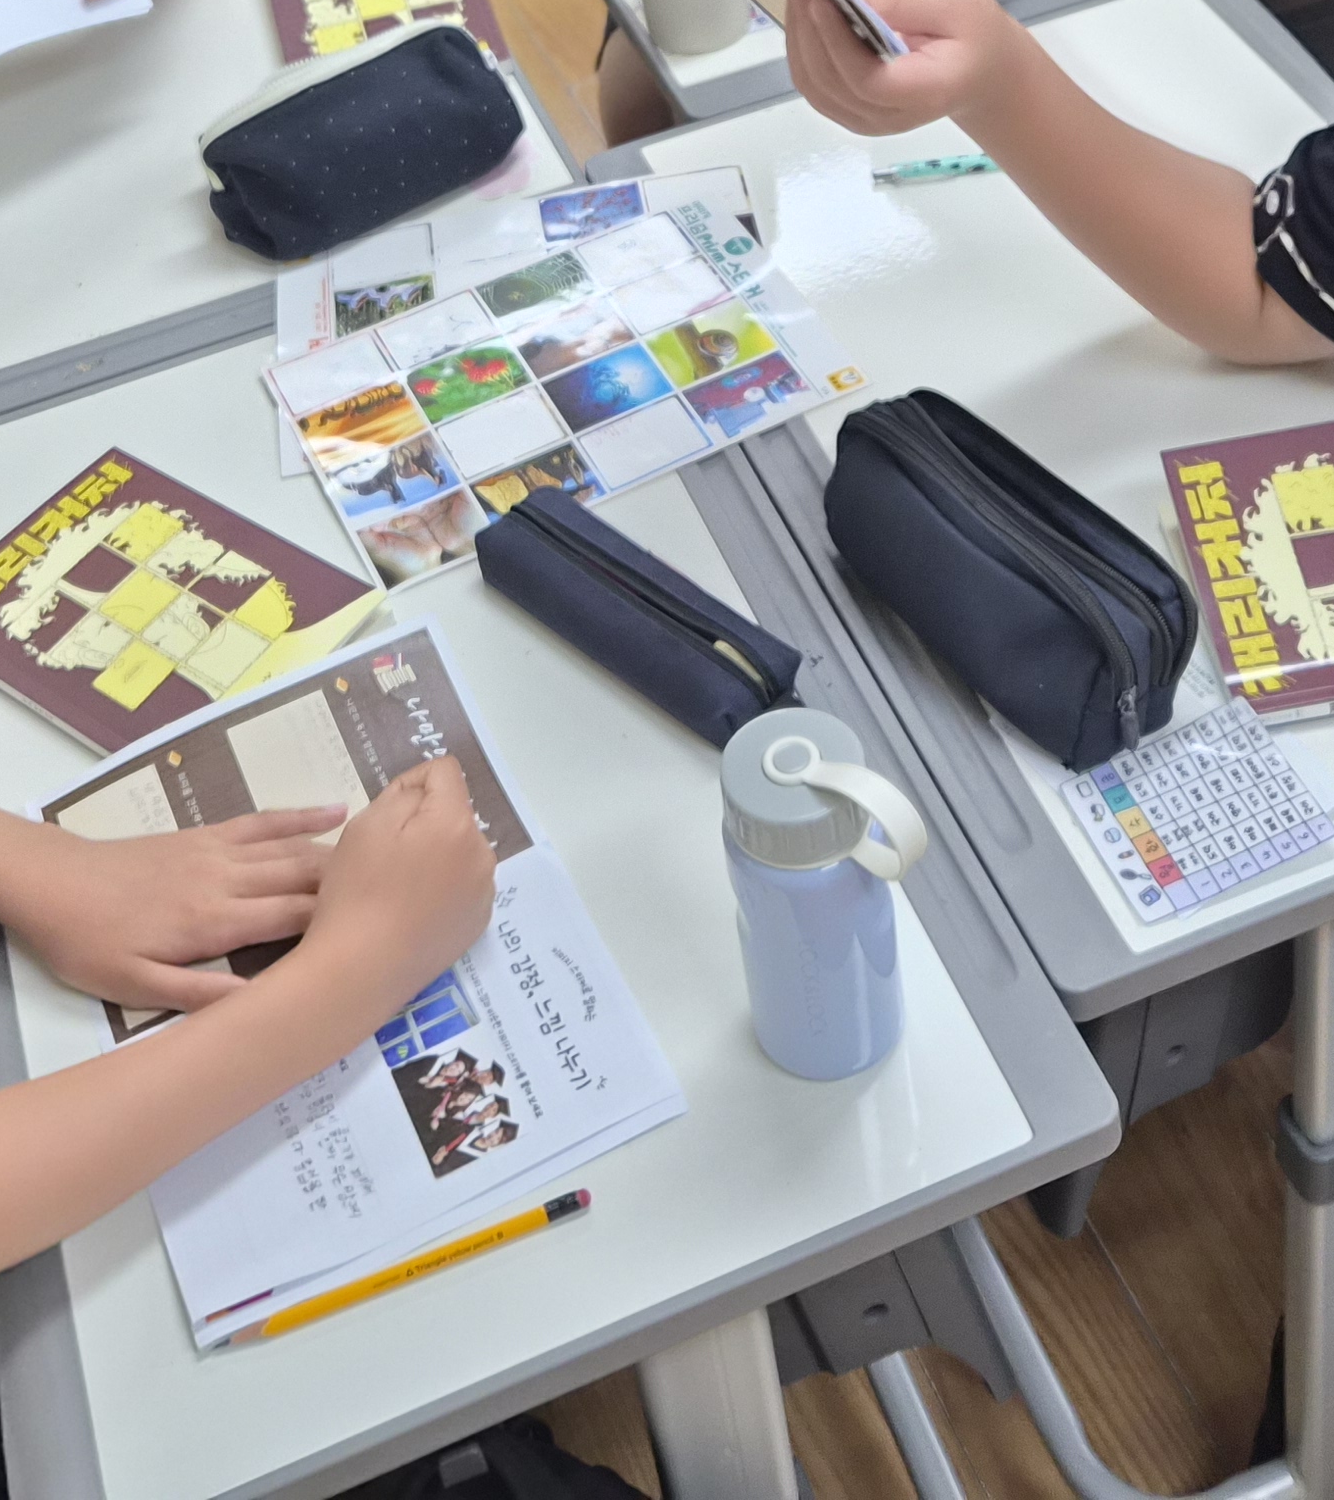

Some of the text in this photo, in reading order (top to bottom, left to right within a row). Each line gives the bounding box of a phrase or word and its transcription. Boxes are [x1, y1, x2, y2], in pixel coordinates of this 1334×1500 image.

[1178, 460, 1283, 697] 캐리커처
[1119, 758, 1135, 776] 영어
[551, 943, 573, 969] 이미지
[569, 962, 593, 995] 스티커로
[496, 921, 594, 1091] 나의 감정, 느낌 나누기
[495, 1027, 514, 1052] 이미지
[504, 1050, 526, 1080] 스티커를
[526, 1095, 545, 1119] 보세요
